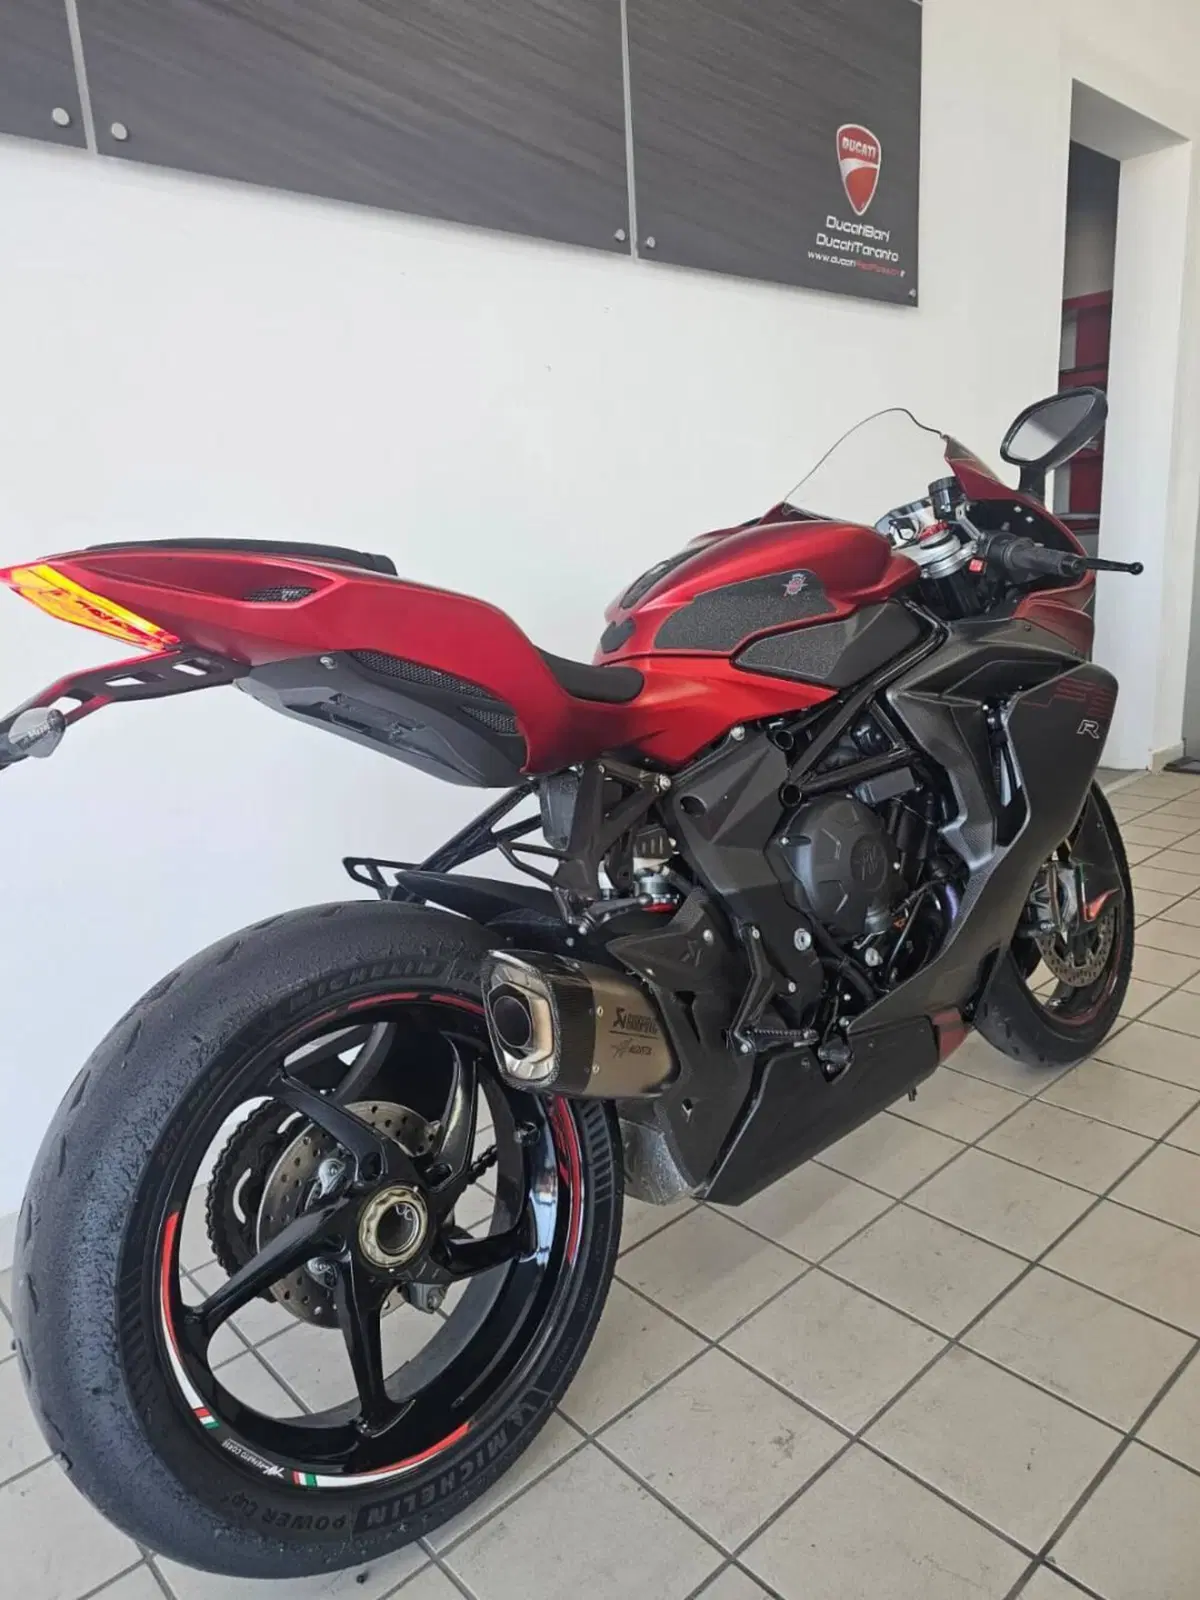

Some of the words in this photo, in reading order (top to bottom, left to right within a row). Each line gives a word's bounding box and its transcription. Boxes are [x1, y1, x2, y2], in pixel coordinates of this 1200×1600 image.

[842, 136, 876, 158] DUCATI
[1076, 719, 1100, 739] R
[367, 1429, 507, 1528] MICHELIN
[261, 1508, 346, 1532] POWER
